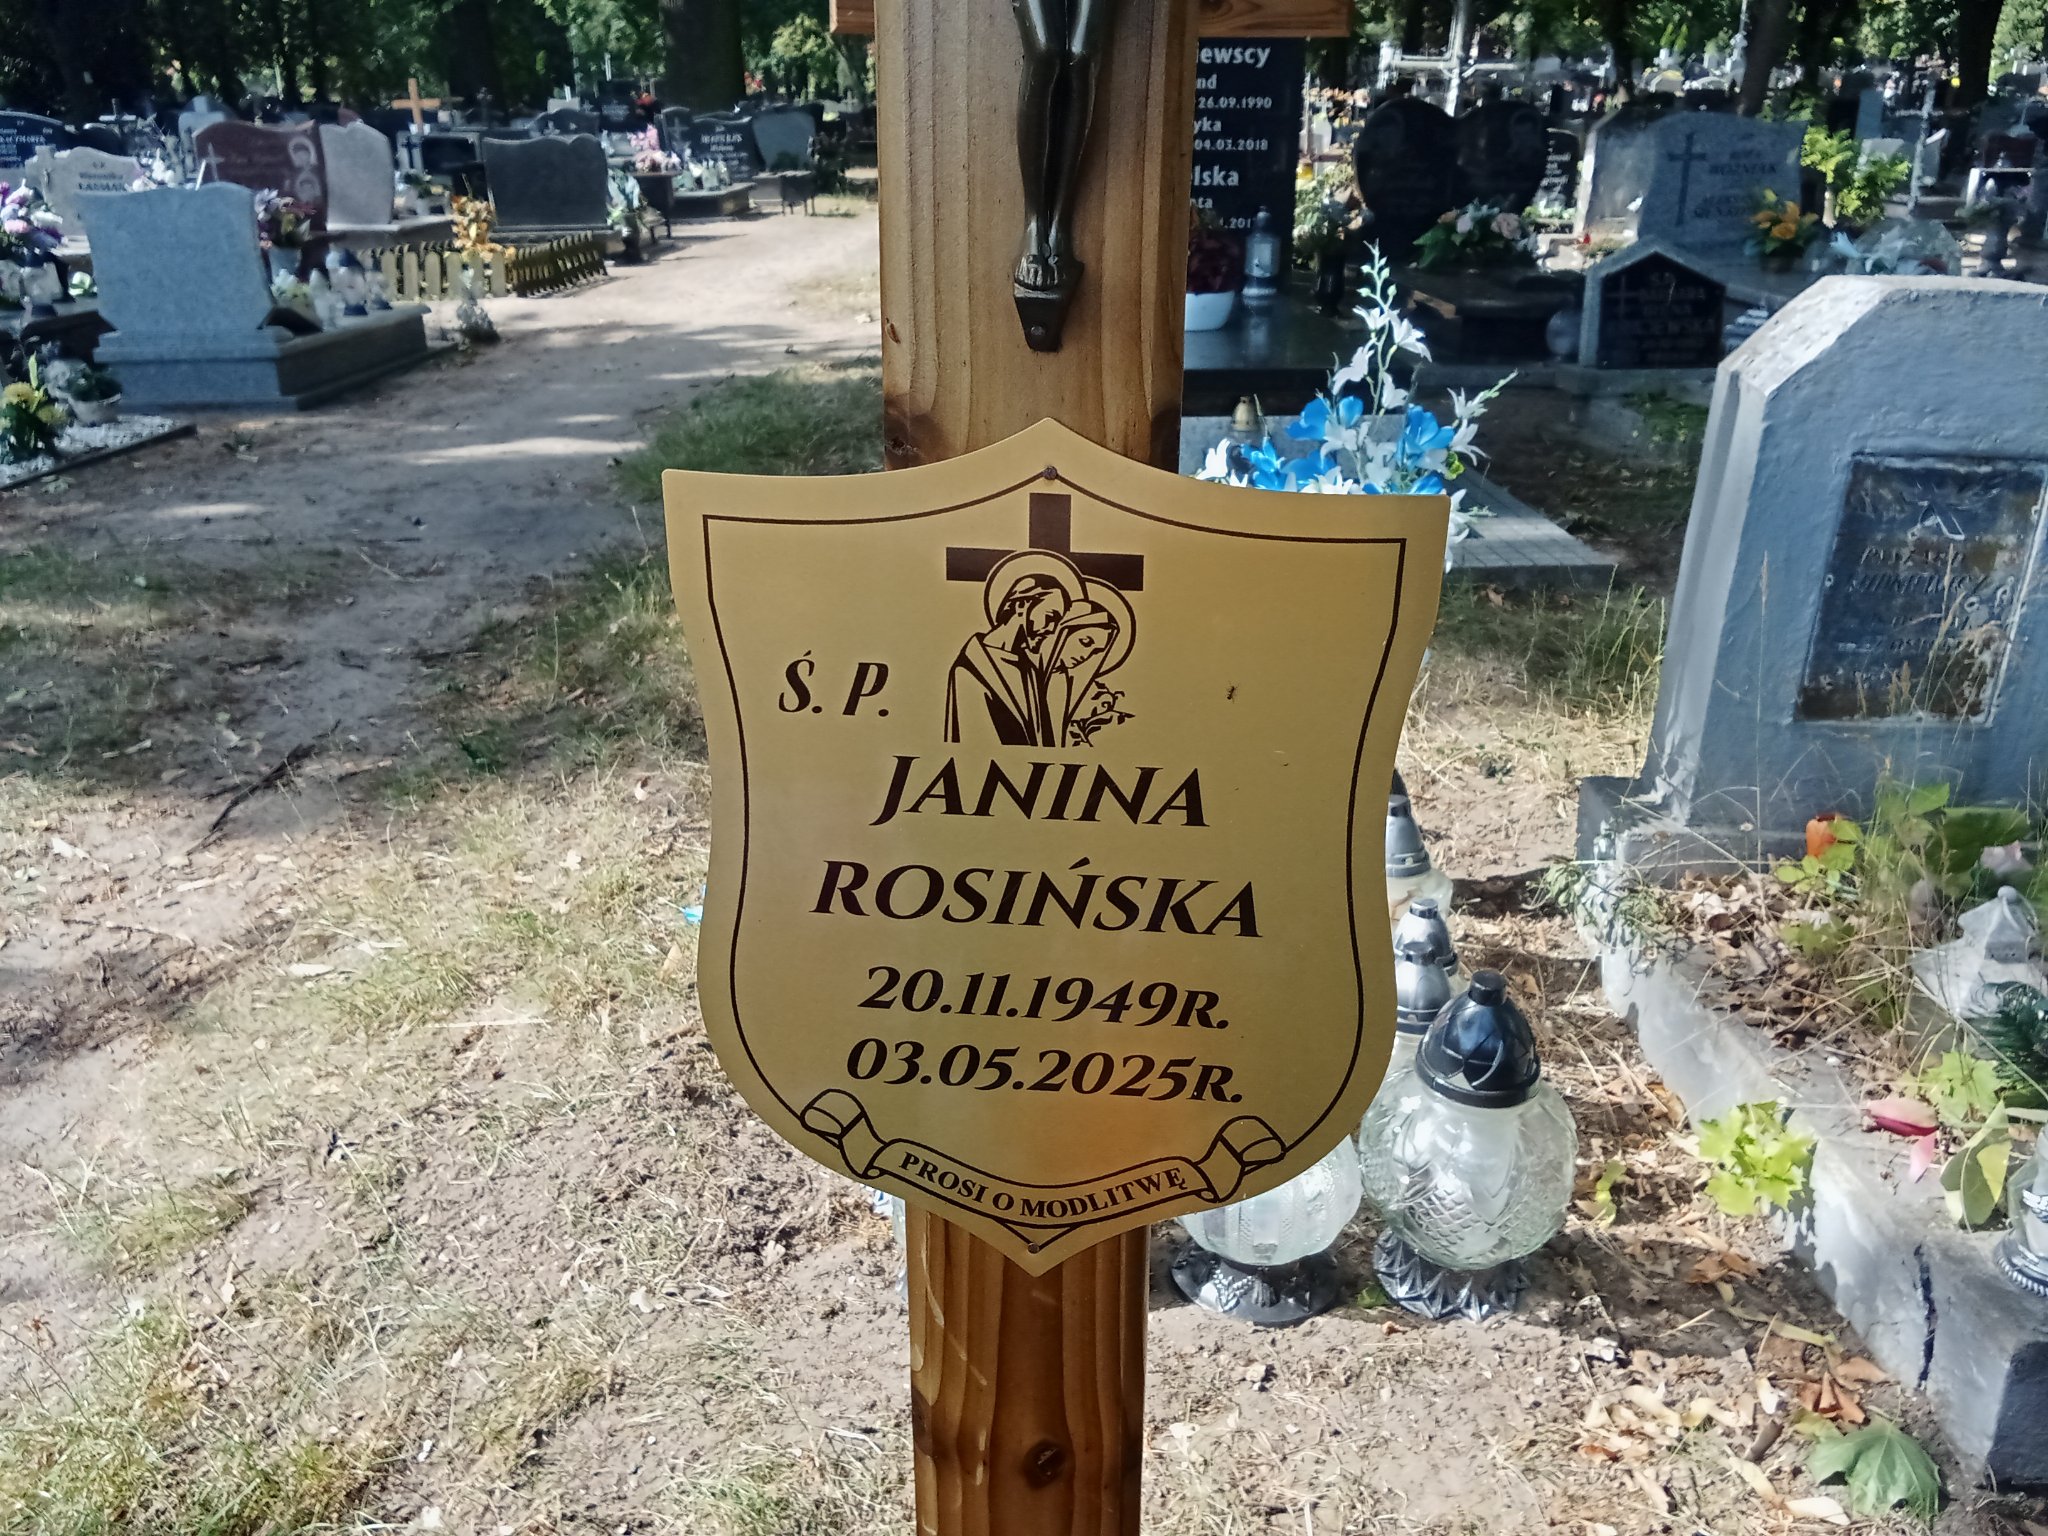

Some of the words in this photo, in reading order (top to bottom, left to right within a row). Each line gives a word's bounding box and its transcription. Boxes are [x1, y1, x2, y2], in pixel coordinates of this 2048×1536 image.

[1191, 164, 1239, 186] lska
[779, 650, 823, 714] Ś.
[843, 663, 889, 717] P.
[869, 756, 1210, 827] JANINA
[809, 857, 1263, 938] ROSIŃSKA
[898, 1152, 989, 1203] PROSI
[992, 1192, 1015, 1211] O
[1019, 1167, 1188, 1218] MODLITWĘ
